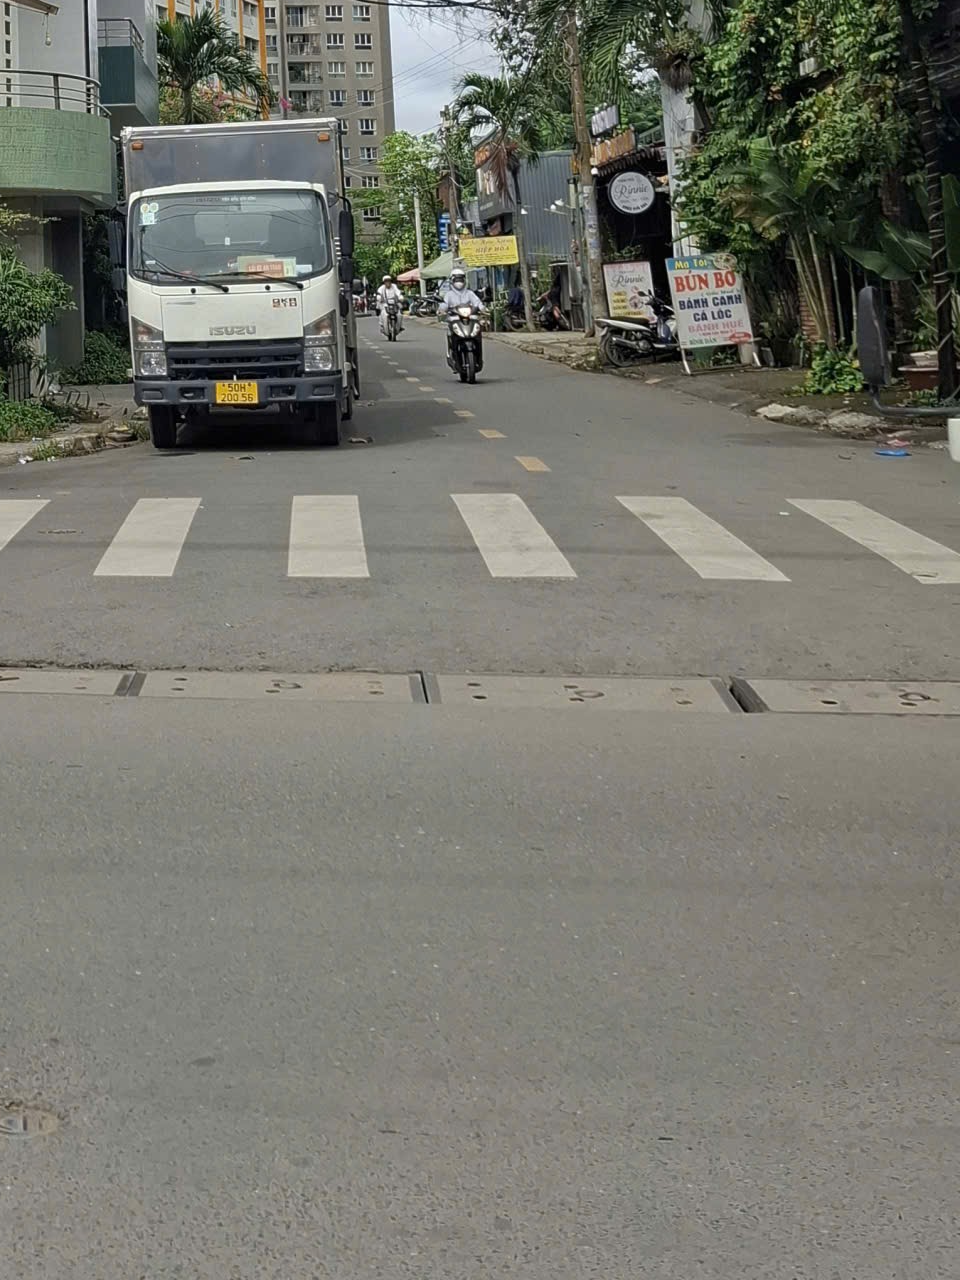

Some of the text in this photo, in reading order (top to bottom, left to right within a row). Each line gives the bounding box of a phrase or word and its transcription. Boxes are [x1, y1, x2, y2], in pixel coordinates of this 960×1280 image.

[674, 270, 709, 293] BÚN
[679, 294, 742, 311] BÁNH CANH
[209, 325, 257, 336] ISUZU
[227, 383, 246, 393] 50H
